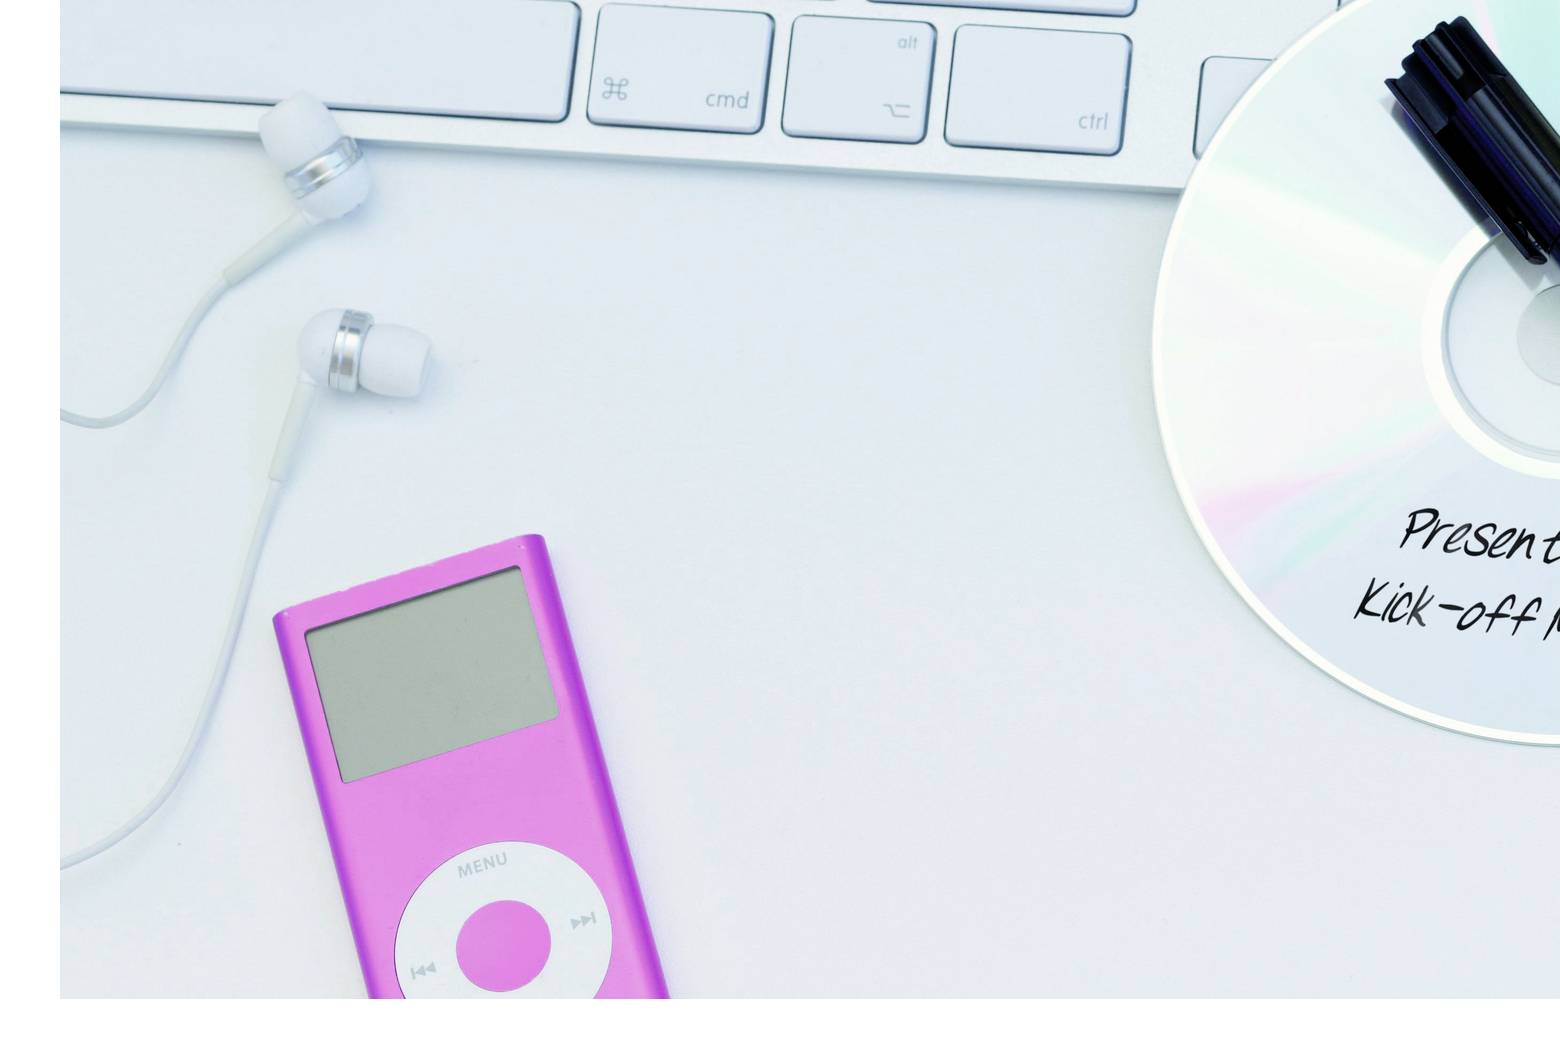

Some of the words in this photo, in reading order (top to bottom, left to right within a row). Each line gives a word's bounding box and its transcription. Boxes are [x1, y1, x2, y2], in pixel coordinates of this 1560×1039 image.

[896, 34, 919, 50] alt
[704, 90, 751, 110] cmd
[1077, 111, 1110, 131] ctrl
[1353, 577, 1542, 636] Kick-off
[456, 851, 509, 879] MENU
